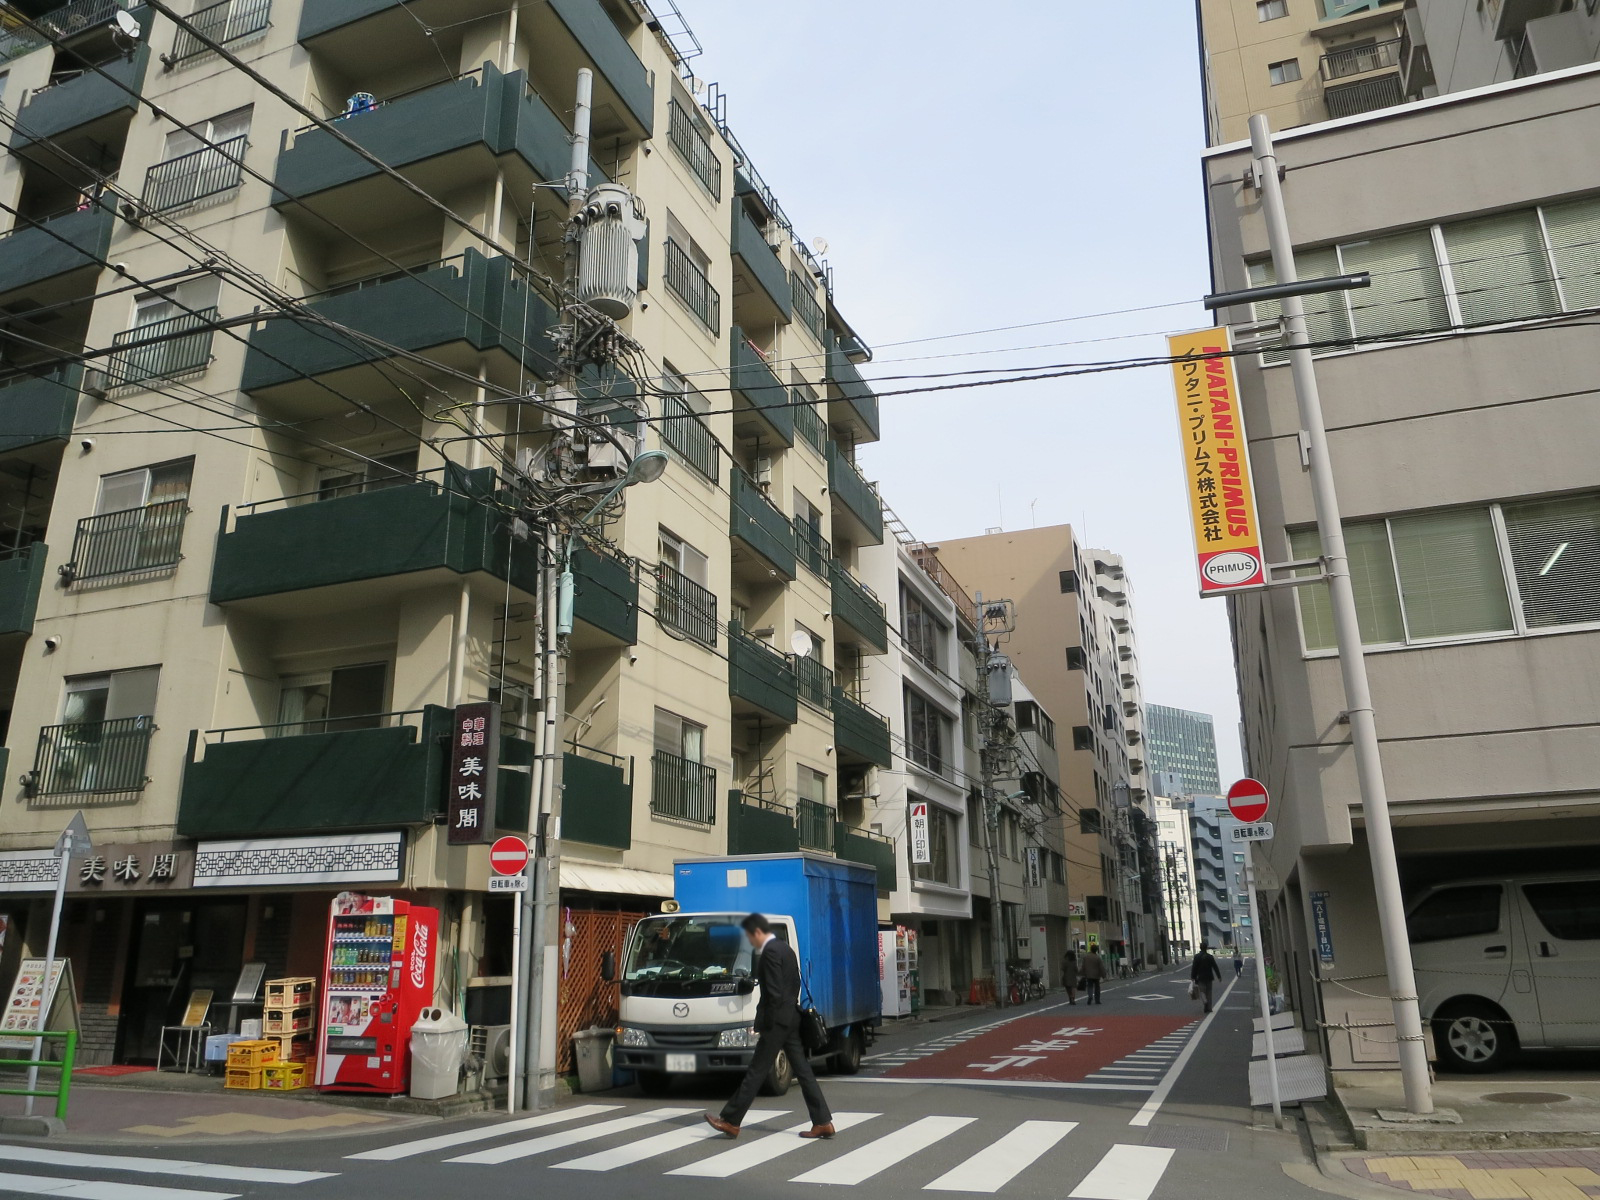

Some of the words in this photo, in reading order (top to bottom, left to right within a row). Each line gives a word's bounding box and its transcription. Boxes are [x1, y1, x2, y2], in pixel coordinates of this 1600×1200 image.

[1181, 347, 1223, 542] イワタニ・プリムス株式会社
[1202, 346, 1249, 537] IWATANI-PRIMUS
[1209, 561, 1253, 574] PRIMUS
[456, 757, 484, 828] 美味閣
[914, 819, 926, 860] 朝川印刷
[1233, 827, 1270, 838] 自転車を除く
[80, 854, 178, 881] 美味閣
[491, 880, 525, 888] 自転車を除く
[410, 920, 429, 989] Coca-Cola
[1320, 944, 1331, 952] 12
